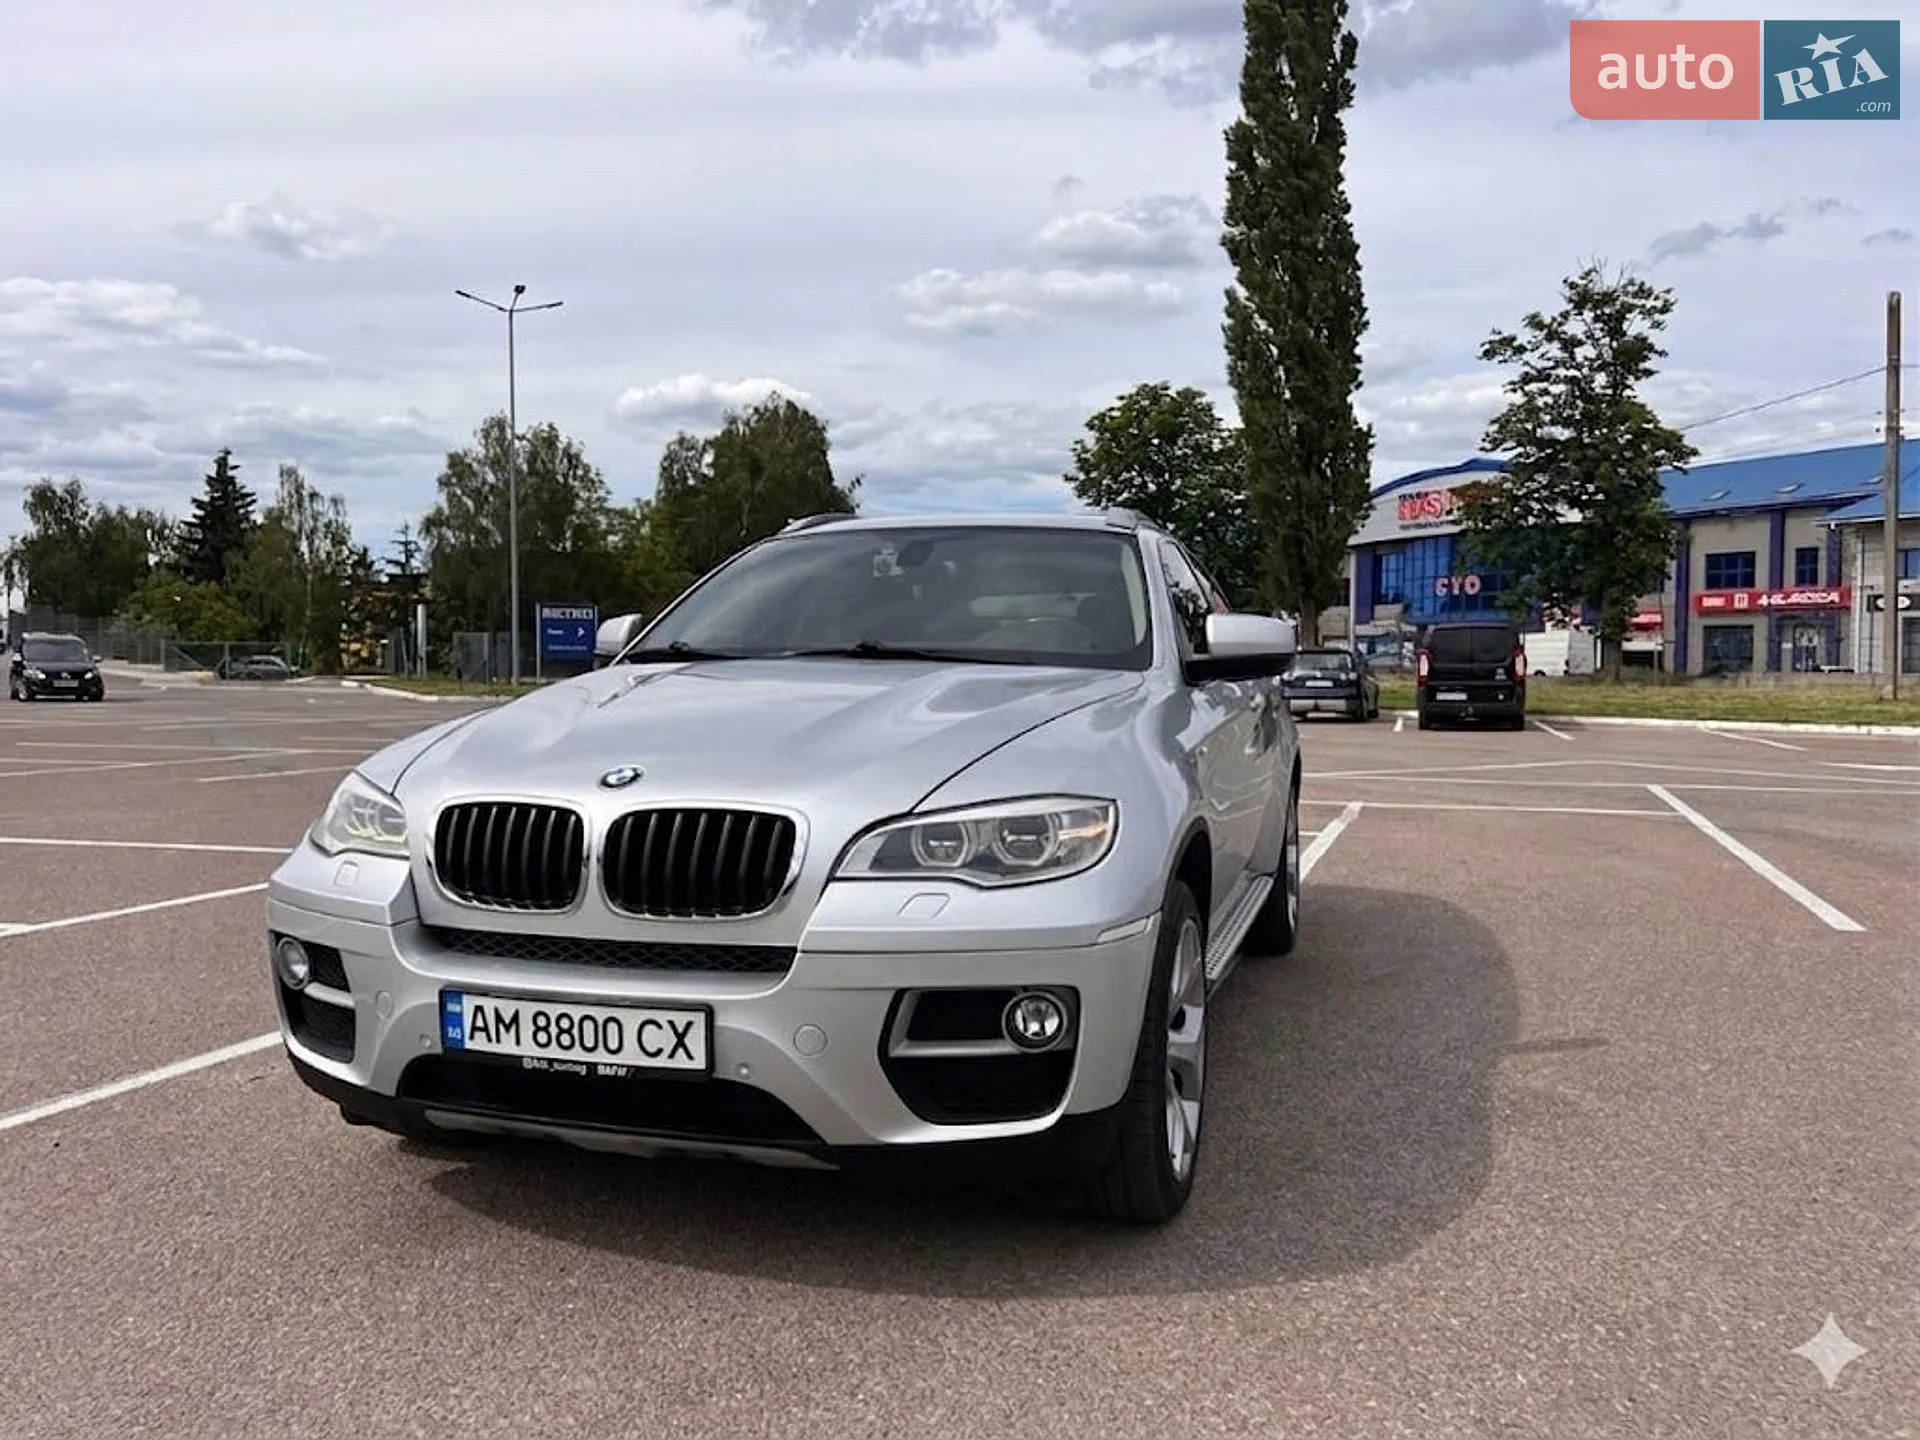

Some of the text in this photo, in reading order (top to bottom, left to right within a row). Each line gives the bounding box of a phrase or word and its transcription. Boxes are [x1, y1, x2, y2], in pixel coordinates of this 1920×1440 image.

[468, 1005, 695, 1061] AM 8800 CX
